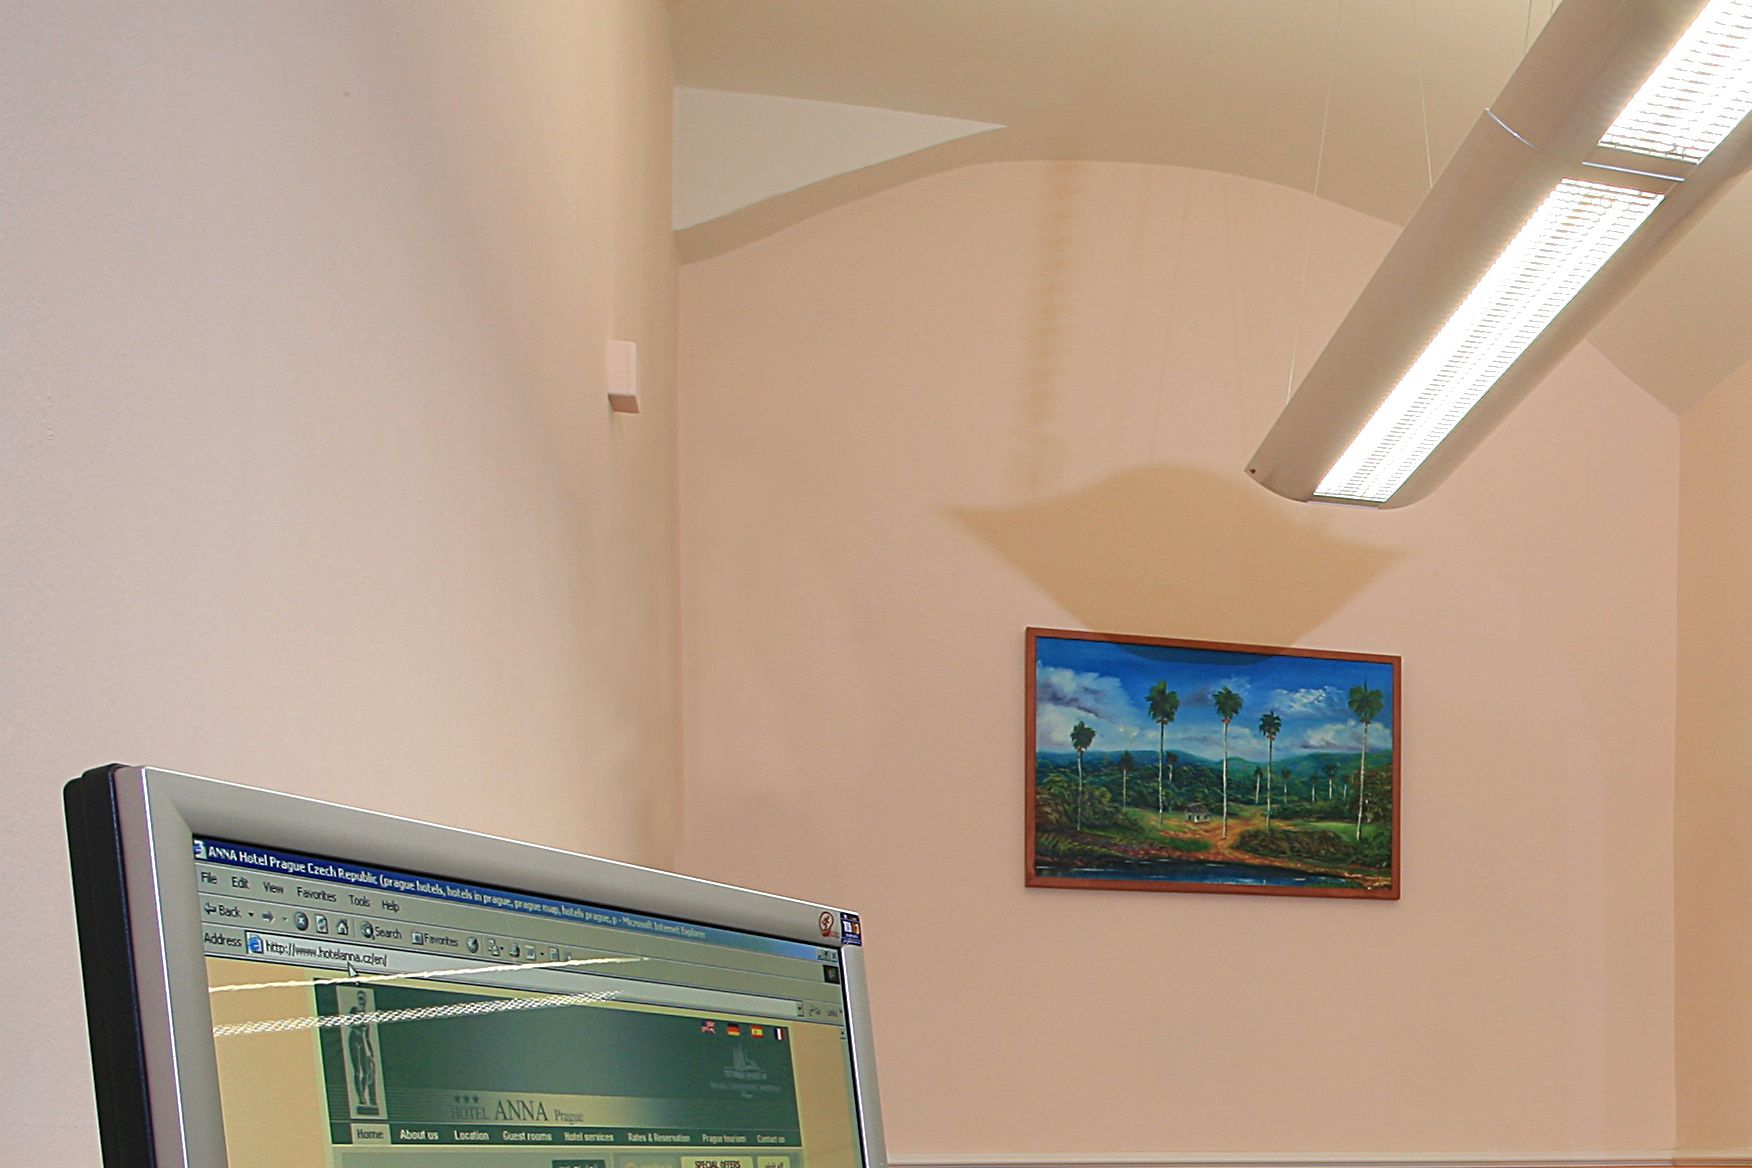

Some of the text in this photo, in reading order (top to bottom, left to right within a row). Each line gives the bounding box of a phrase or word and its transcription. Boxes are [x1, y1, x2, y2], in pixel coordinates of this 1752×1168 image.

[208, 846, 236, 861] ANNA
[239, 853, 268, 866] Hotel
[270, 857, 305, 873] Prague
[308, 863, 337, 878] Czech
[338, 868, 377, 884] Republic
[380, 874, 414, 891] (prague
[416, 880, 445, 897] hotels,
[447, 885, 472, 900] hotels
[201, 872, 400, 913] File Edit View Favorites Tools Help
[204, 933, 242, 947] Address
[219, 905, 458, 947] Back Search Favorites
[451, 1100, 584, 1125] HOTEL ANNA Prague
[357, 1128, 384, 1139] Home
[400, 1129, 426, 1140] About
[428, 1132, 439, 1140] us
[454, 1129, 489, 1140] Location
[503, 1130, 526, 1141] Guest
[527, 1132, 552, 1141] rooms
[564, 1132, 582, 1141] Hotel
[584, 1132, 614, 1142] services
[702, 1133, 723, 1144] Prague
